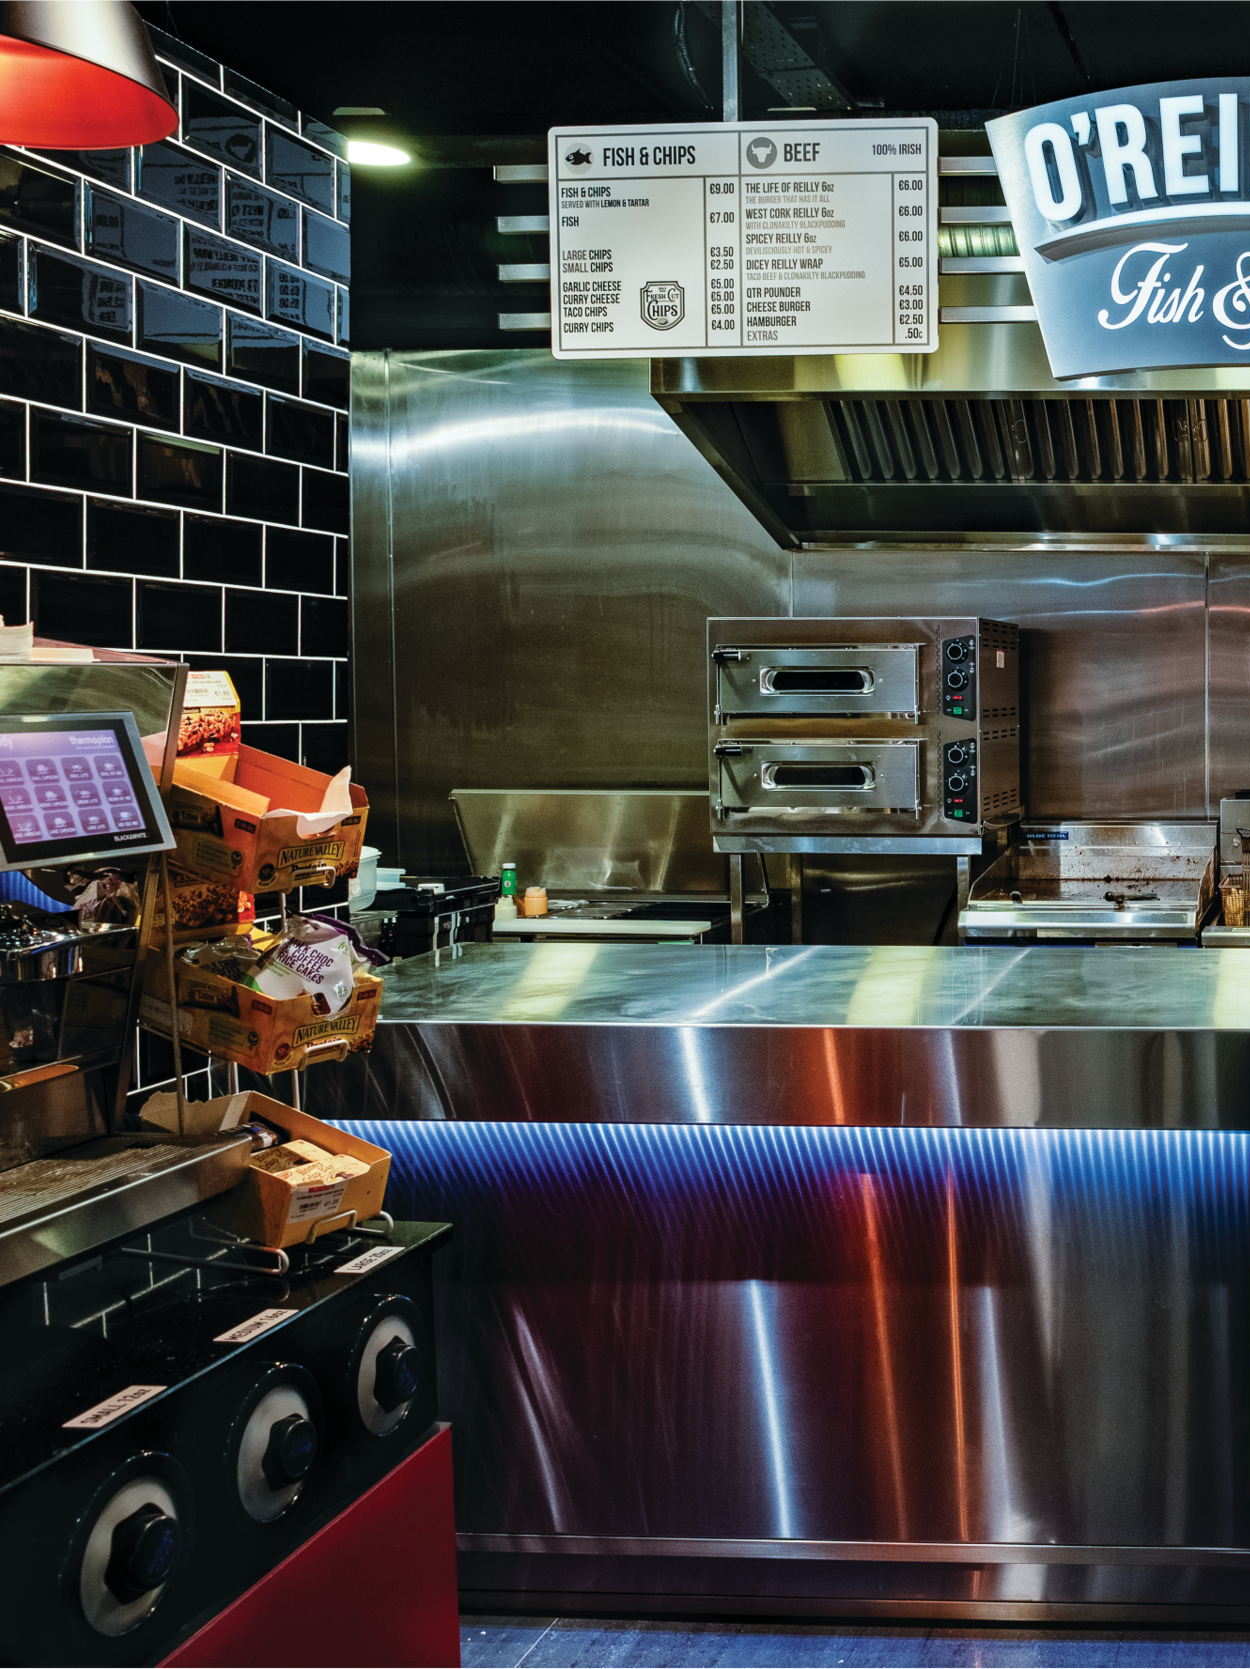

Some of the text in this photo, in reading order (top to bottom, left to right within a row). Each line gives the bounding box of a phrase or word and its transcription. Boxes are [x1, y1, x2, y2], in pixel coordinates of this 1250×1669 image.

[784, 143, 820, 162] BEEF
[872, 144, 921, 155] 100% IRISH
[603, 146, 696, 167] FISH & CHIPS
[710, 183, 734, 194] €9.00
[745, 183, 760, 193] THE
[763, 183, 779, 193] LIFE
[781, 182, 791, 192] OF
[794, 182, 819, 192] REILLY
[899, 180, 922, 191] €6.00
[561, 187, 611, 198] FISH & CHIPS
[561, 199, 649, 209] SERVED WITH LEMON & TARTAR
[562, 216, 579, 227] FISH
[710, 212, 734, 223] €7.00
[563, 250, 612, 260] LARGE CHIPS
[711, 247, 733, 257] €3.50
[563, 262, 613, 273] SMALL CHIPS
[711, 260, 733, 270] €2.50
[746, 259, 823, 270] DICEY REILLY WRAP
[899, 257, 922, 267] €5.00
[747, 271, 865, 281] TACO BEEF & CLONAKILTY BLACKPUDDING
[1098, 242, 1206, 329] Fish
[747, 316, 797, 327] HAMBURGER
[69, 735, 114, 745] thermoplan
[281, 842, 342, 865] NATURE VALLEY
[292, 950, 324, 973] COFFEE
[310, 950, 334, 967] CHOC
[276, 952, 324, 984] RICE CAKES
[295, 1018, 357, 1044] NATURE VALLEY
[80, 1403, 127, 1424] SMALL
